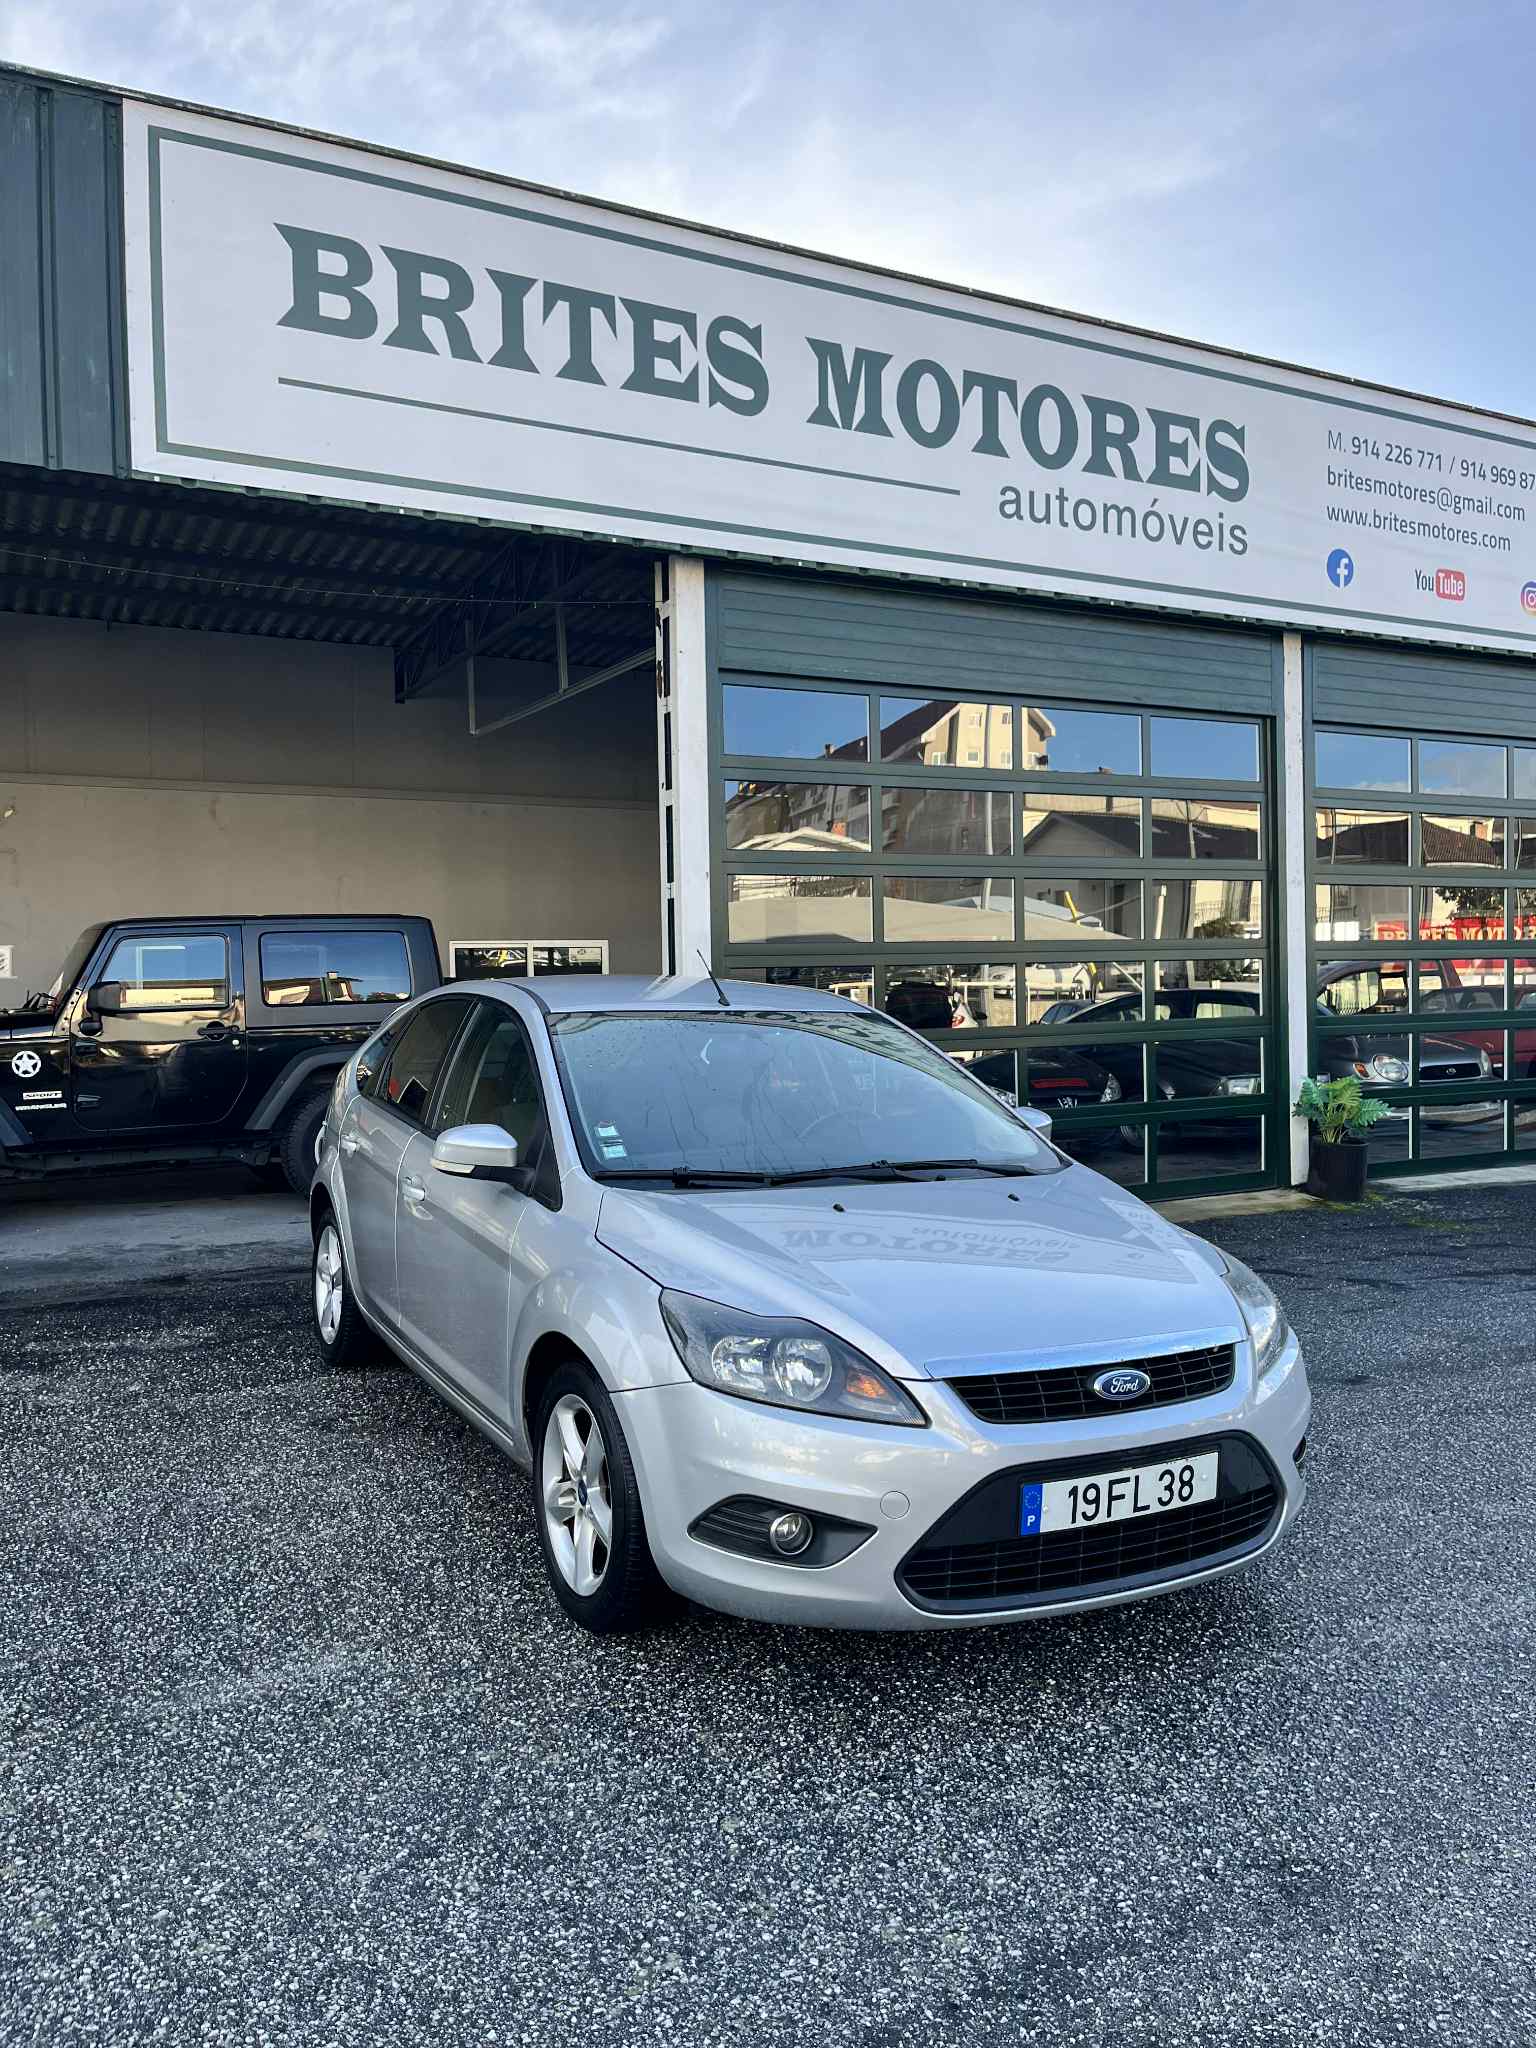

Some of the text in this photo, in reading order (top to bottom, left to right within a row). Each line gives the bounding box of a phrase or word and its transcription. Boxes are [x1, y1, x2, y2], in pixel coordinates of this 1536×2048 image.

[274, 223, 1249, 502] BRITES MOTORES
[1327, 430, 1347, 453] M.
[1351, 436, 1381, 460] 914
[1384, 443, 1413, 466] 226
[1416, 450, 1443, 473] 771
[1460, 459, 1487, 481] 914
[1490, 465, 1516, 486] 969
[998, 485, 1248, 555] automóveis
[1327, 465, 1526, 521] britesmotores@gmail.com
[1326, 505, 1512, 551] www.britesmotores.com
[1110, 1377, 1139, 1394] Ford
[1027, 1515, 1036, 1527] P
